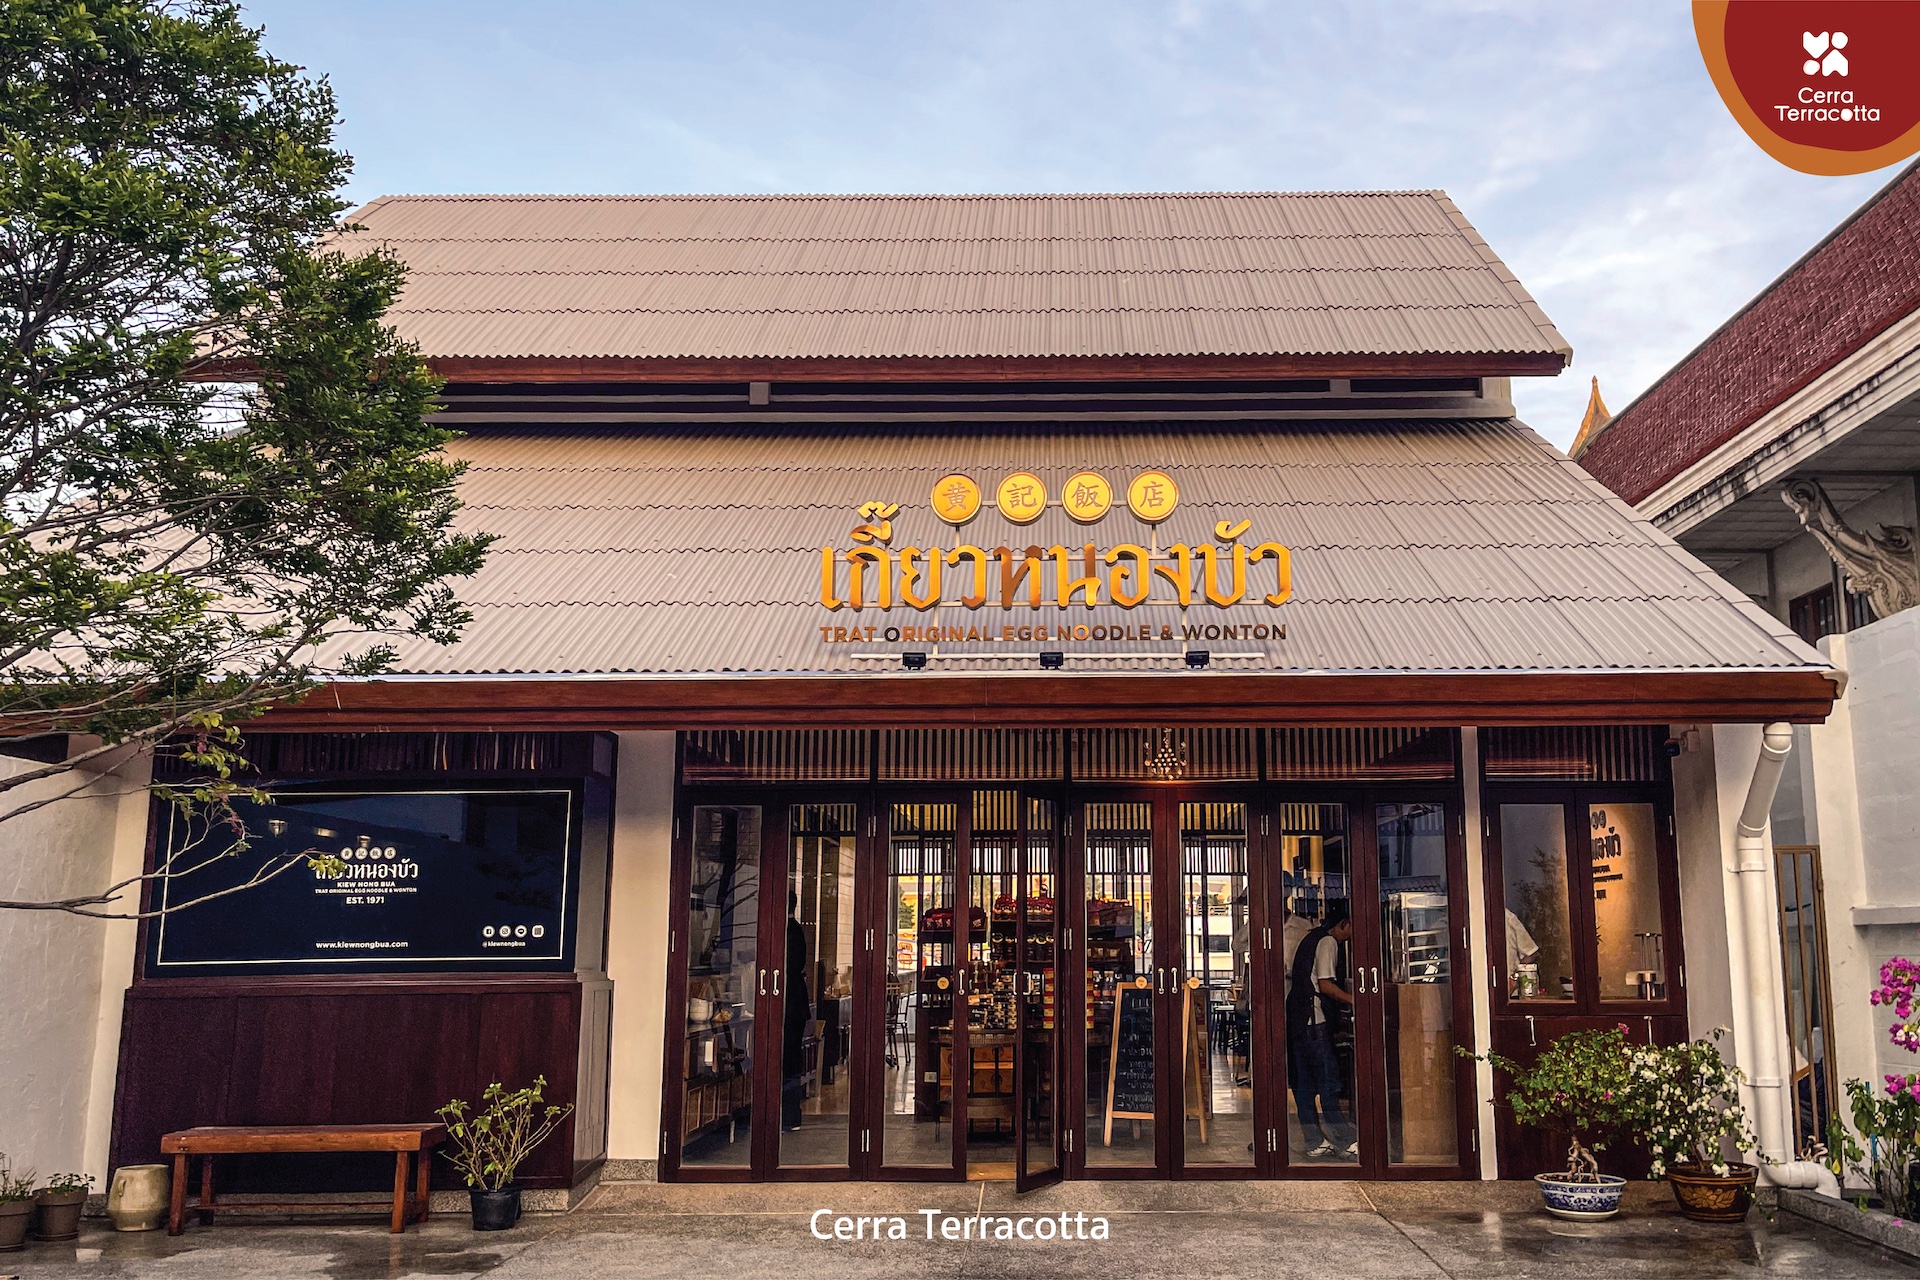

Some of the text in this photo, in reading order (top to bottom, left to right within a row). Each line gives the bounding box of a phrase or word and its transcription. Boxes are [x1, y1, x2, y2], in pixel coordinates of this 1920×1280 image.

[821, 500, 1292, 611] เกี๊ยวหนองบัว
[820, 624, 1287, 643] TRAT ORIGINAL EGG NOODLE & WONTON
[346, 896, 385, 905] EST. 1971
[315, 941, 409, 950] www.kiewnongbua.com
